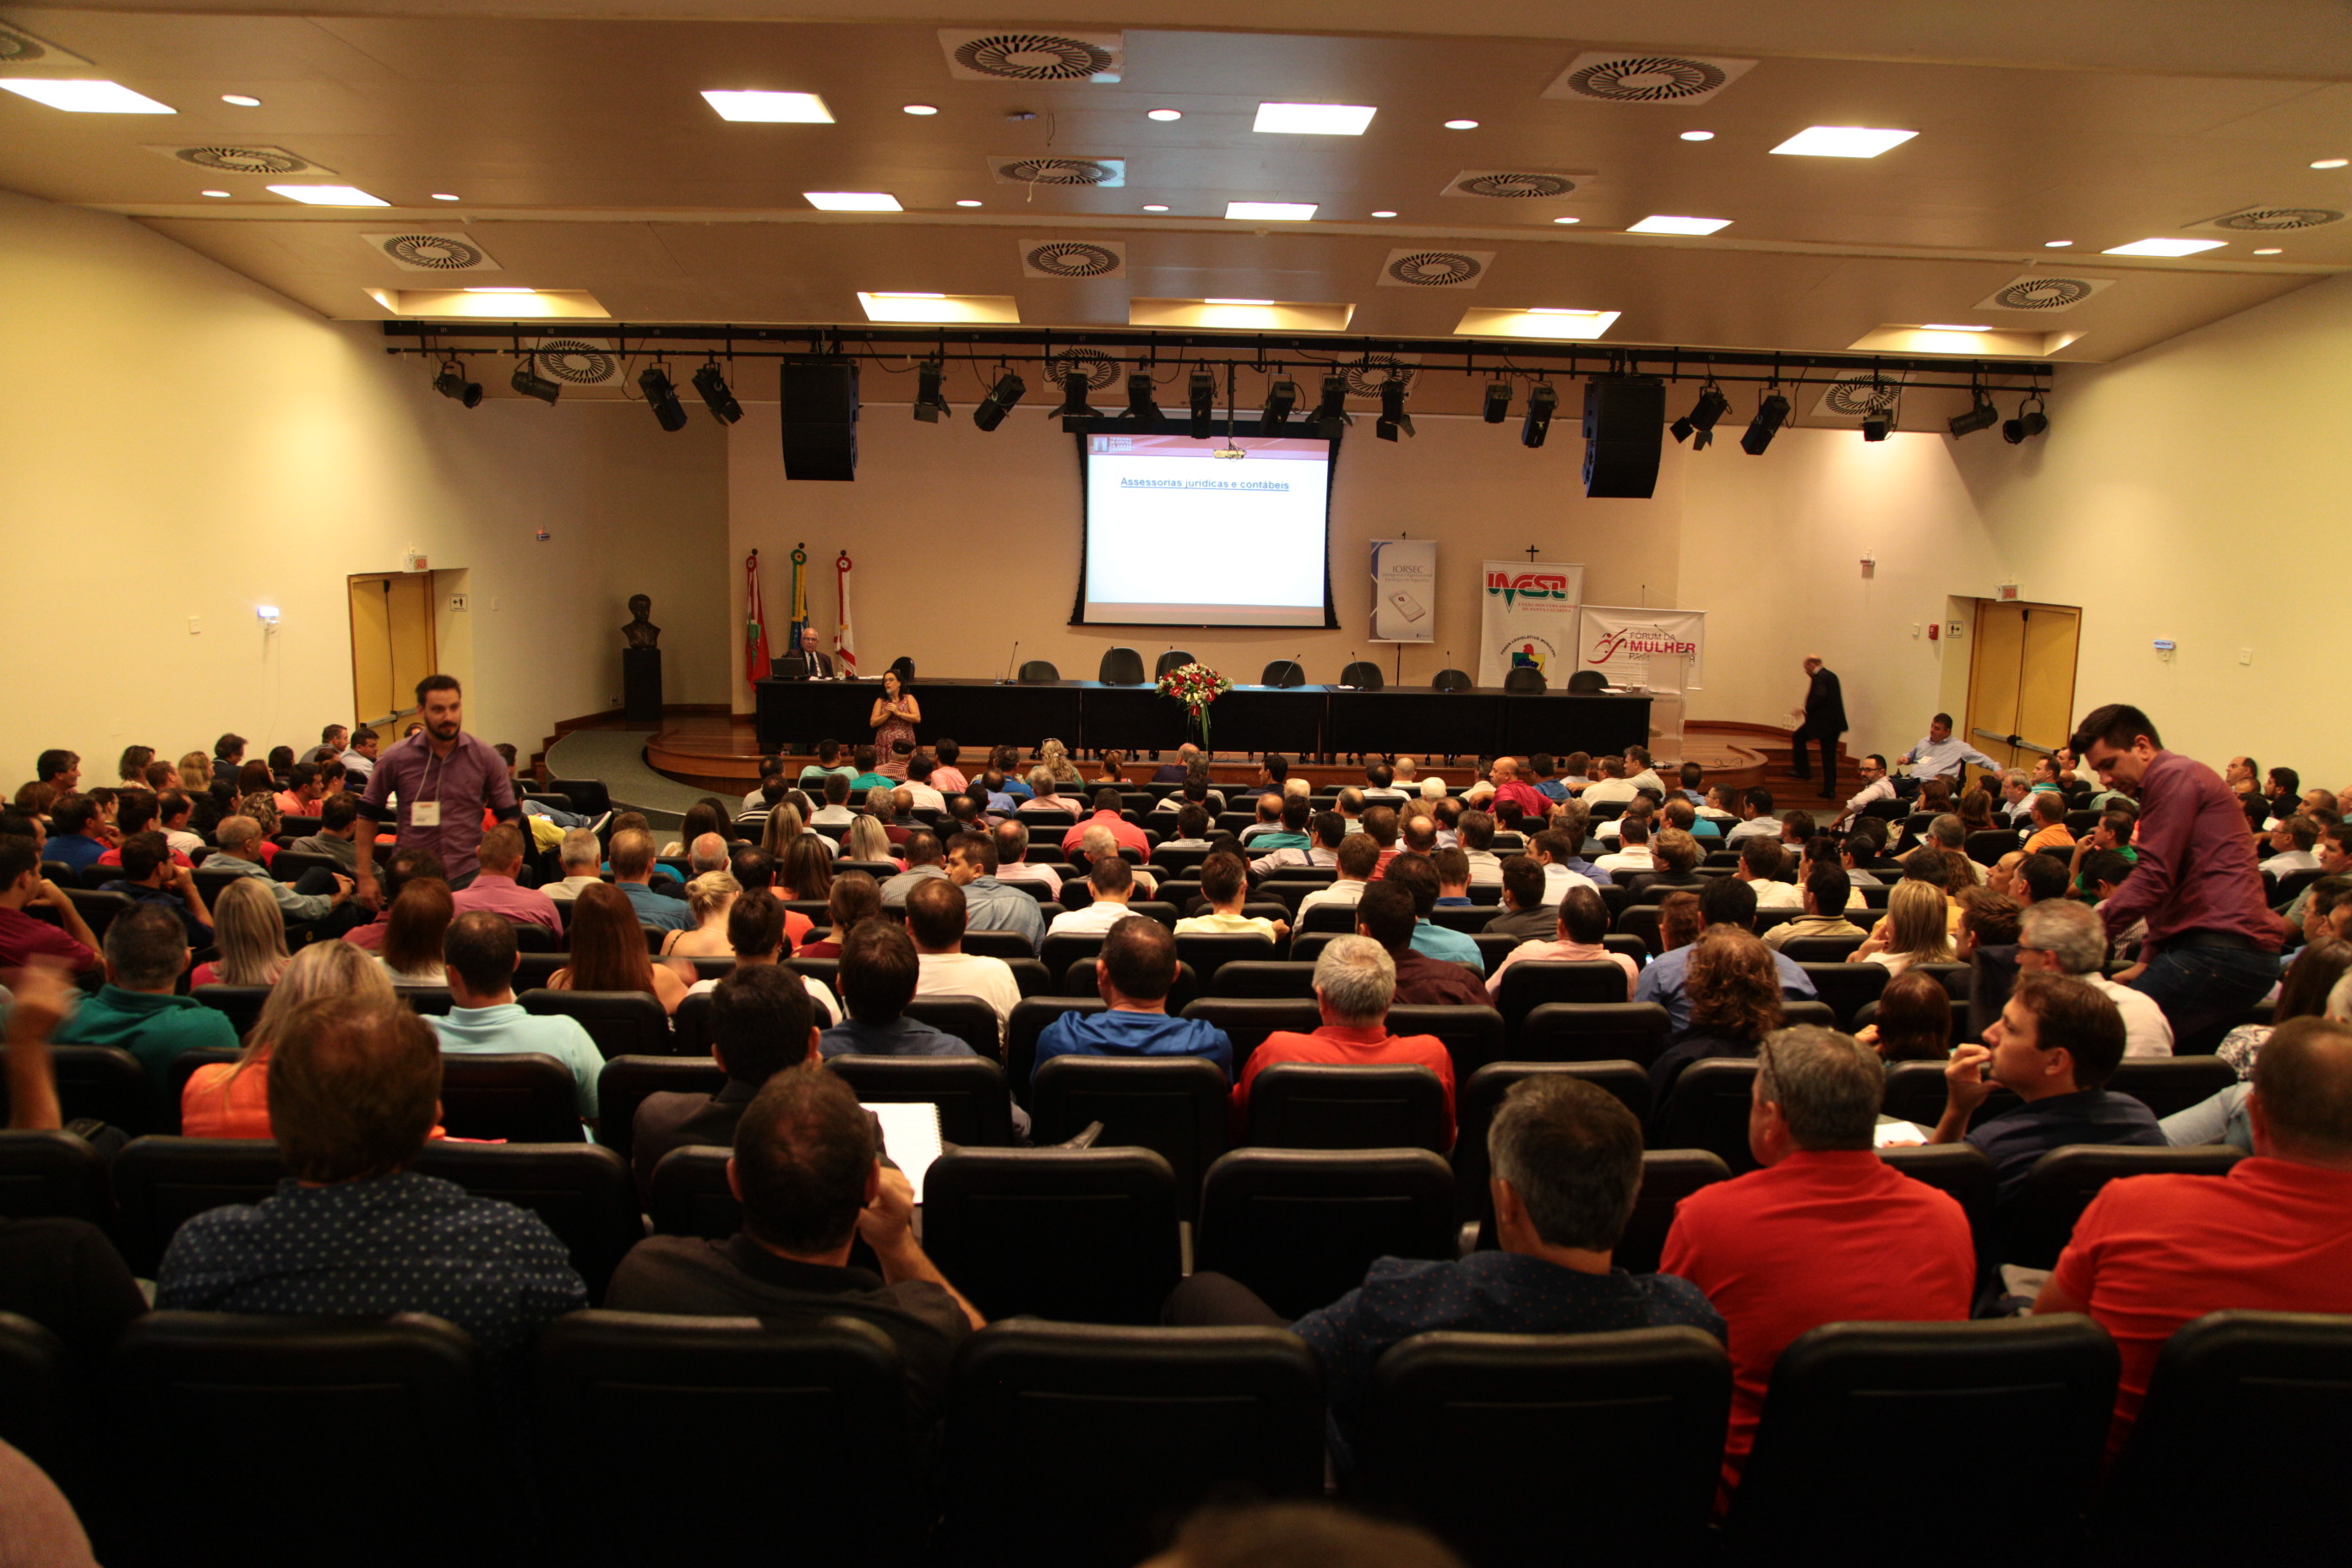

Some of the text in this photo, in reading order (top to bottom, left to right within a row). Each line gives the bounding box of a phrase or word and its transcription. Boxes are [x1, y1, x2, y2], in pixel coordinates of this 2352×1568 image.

[1121, 477, 1182, 487] Assessorias
[1185, 478, 1228, 488] jurídicas
[1240, 480, 1289, 490] contábeis
[1392, 564, 1424, 573] IORSEC
[1631, 630, 1661, 640] FÓRUM
[1500, 642, 1511, 655] PODER
[1540, 639, 1556, 658] MUNICIPAL
[1630, 640, 1696, 653] MULHER
